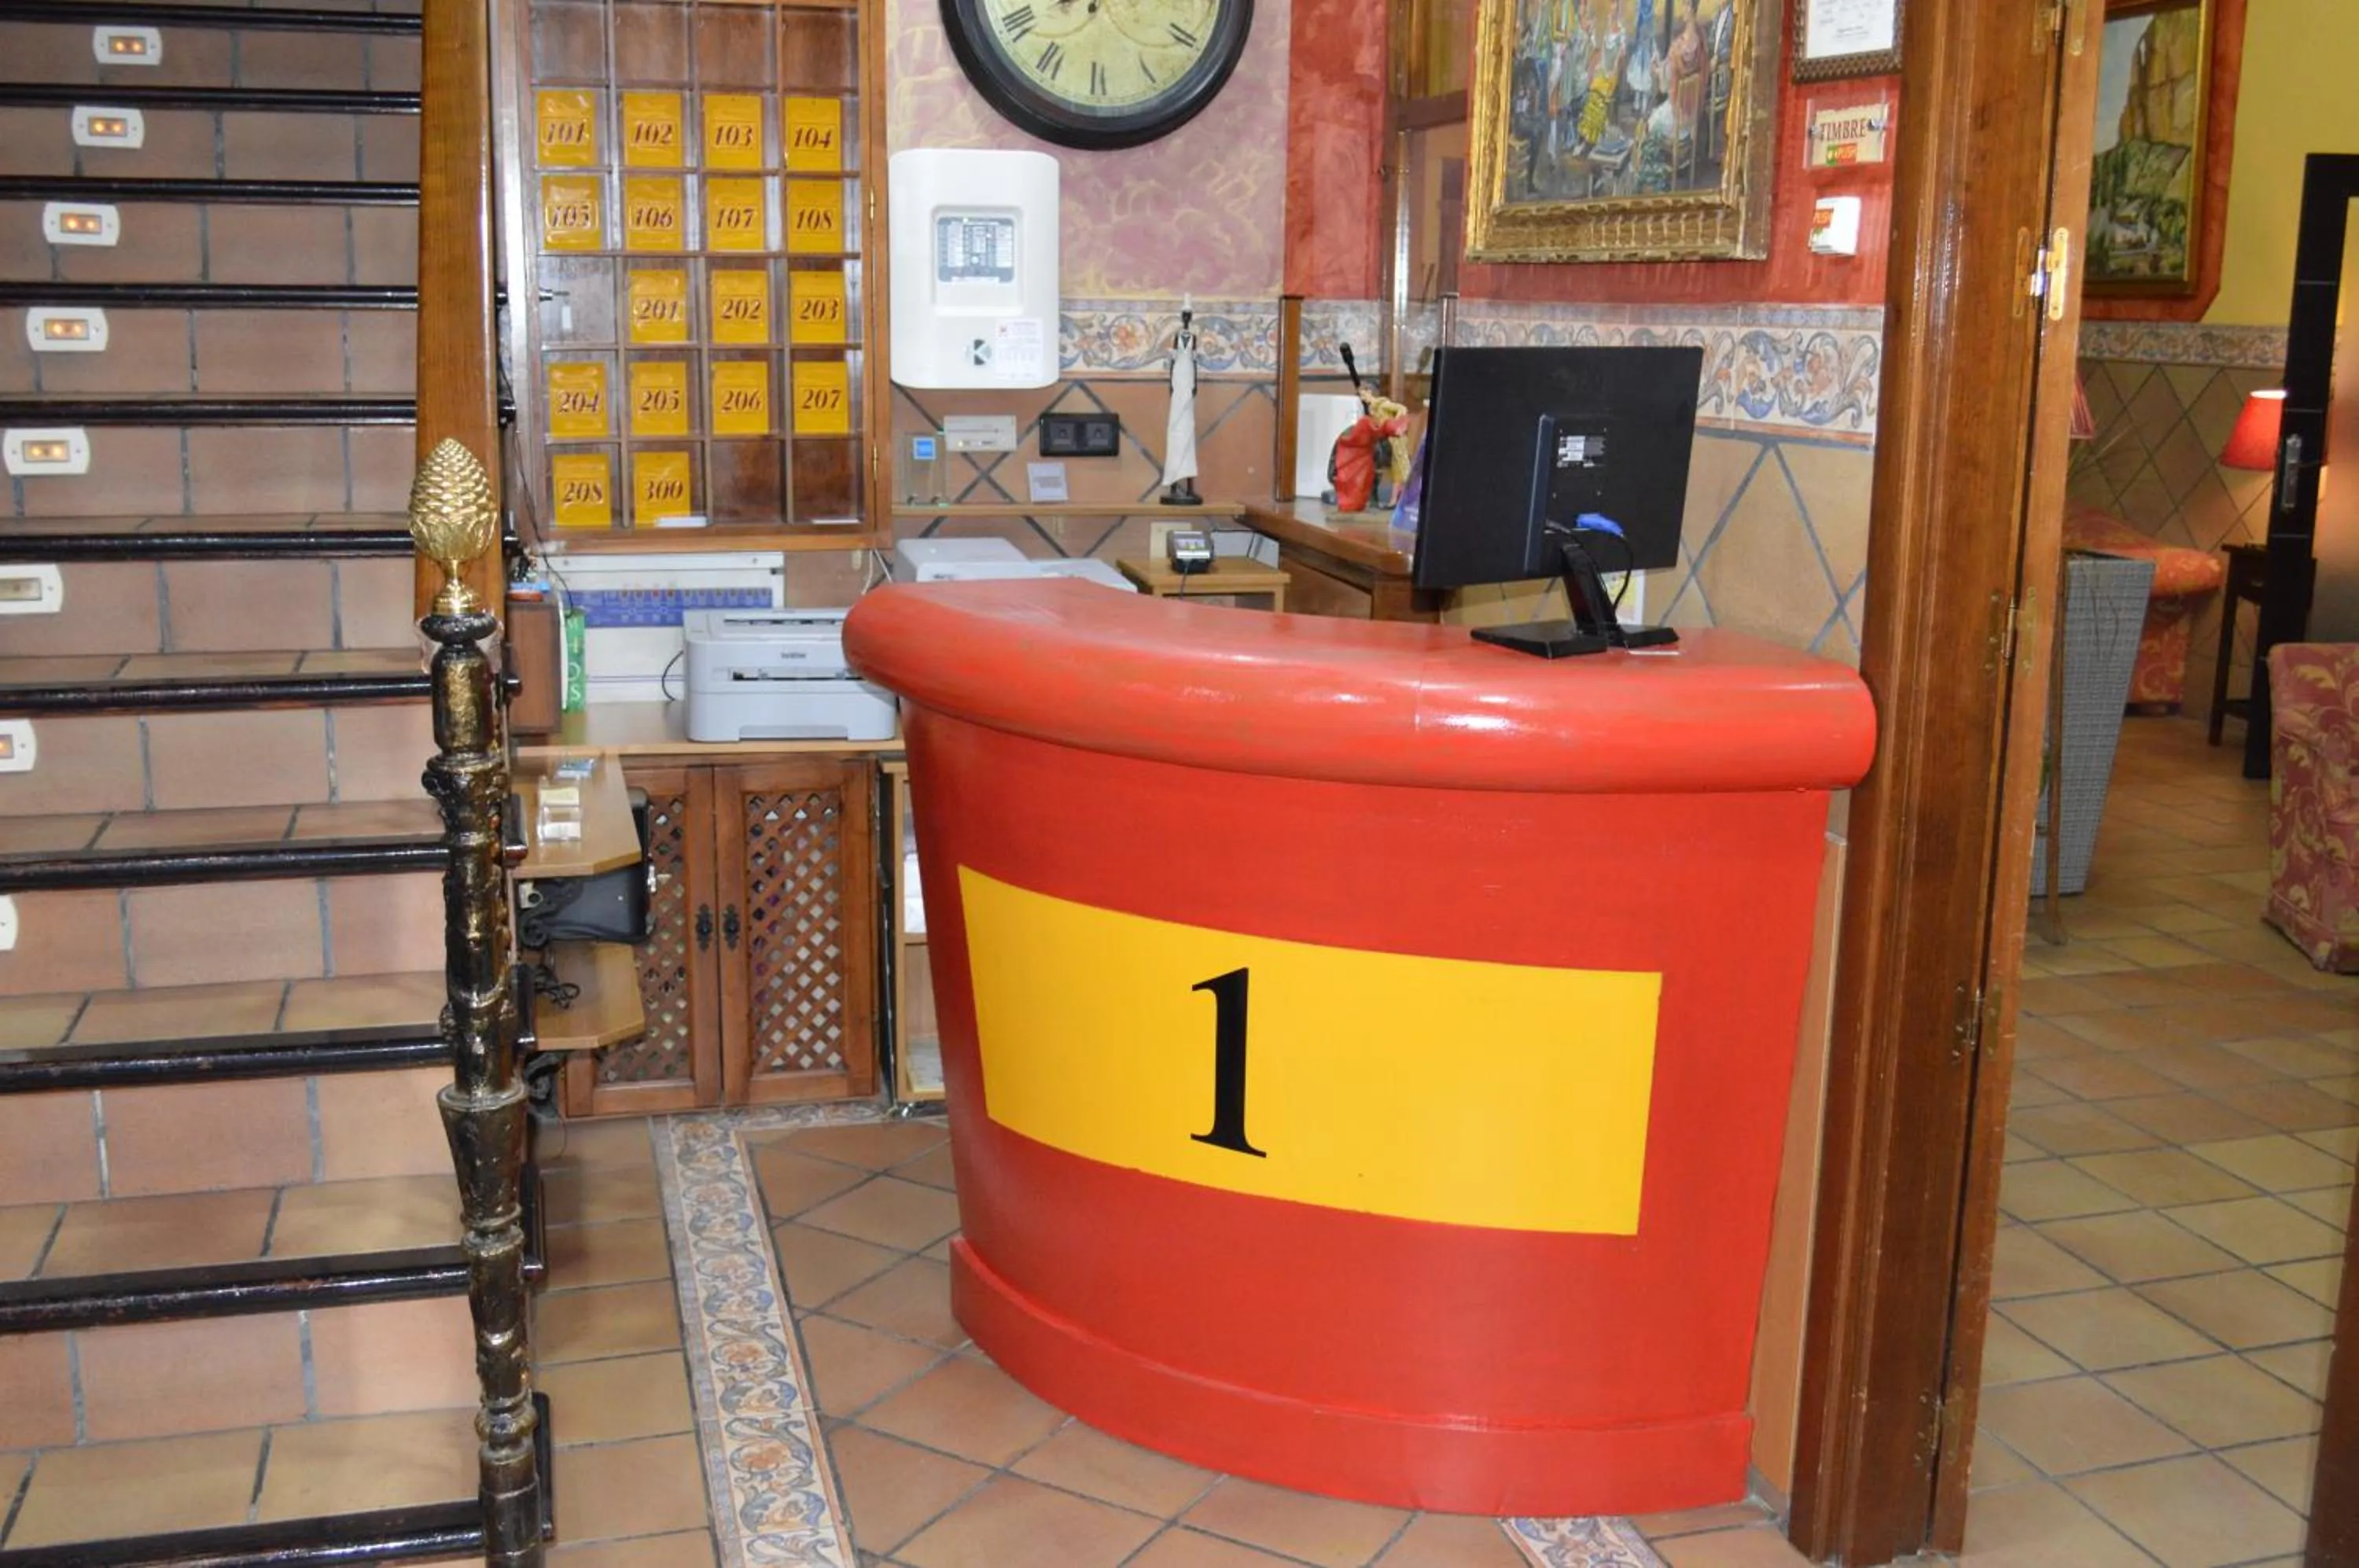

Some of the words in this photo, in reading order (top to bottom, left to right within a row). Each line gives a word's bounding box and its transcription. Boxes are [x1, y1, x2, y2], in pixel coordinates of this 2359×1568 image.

[546, 123, 586, 145] 101
[634, 123, 673, 145] 102
[715, 125, 753, 147] 103
[793, 126, 833, 149] 104
[1820, 118, 1867, 142] TIMBRE
[551, 205, 591, 228] 105
[635, 206, 674, 228] 106
[716, 207, 756, 229] 107
[796, 208, 834, 230] 108
[638, 300, 680, 322] 201
[721, 300, 761, 322] 202
[798, 300, 839, 322] 203
[559, 392, 599, 414] 204
[640, 390, 680, 412] 205
[721, 390, 761, 412] 206
[801, 388, 842, 410] 207
[563, 481, 604, 503] 208
[643, 479, 683, 502] 300
[1190, 966, 1267, 1159] 1
